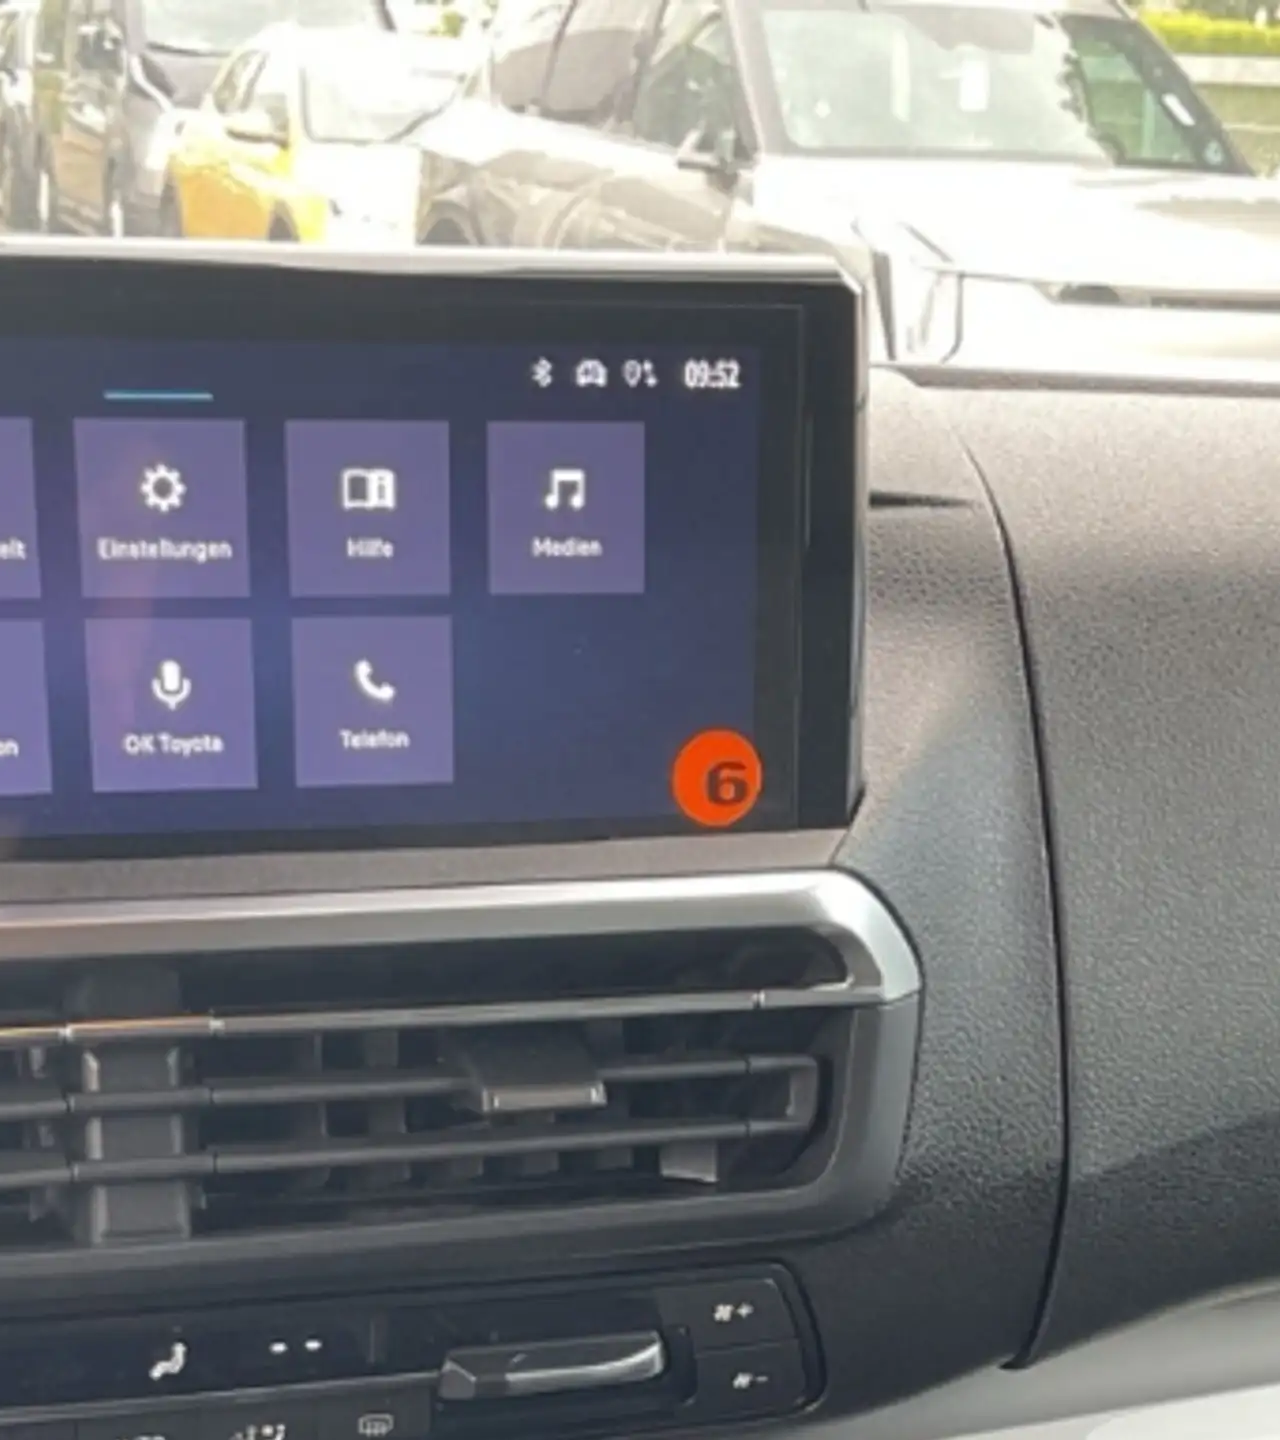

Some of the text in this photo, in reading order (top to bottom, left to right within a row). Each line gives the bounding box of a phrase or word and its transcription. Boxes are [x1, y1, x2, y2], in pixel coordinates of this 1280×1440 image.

[684, 358, 741, 389] 09:52
[97, 537, 233, 563] Einstellungen
[346, 535, 395, 558] Hilfe
[532, 535, 603, 558] Medien
[123, 732, 224, 758] OK Toyota
[339, 729, 411, 749] Telefon
[706, 760, 749, 807] 6
